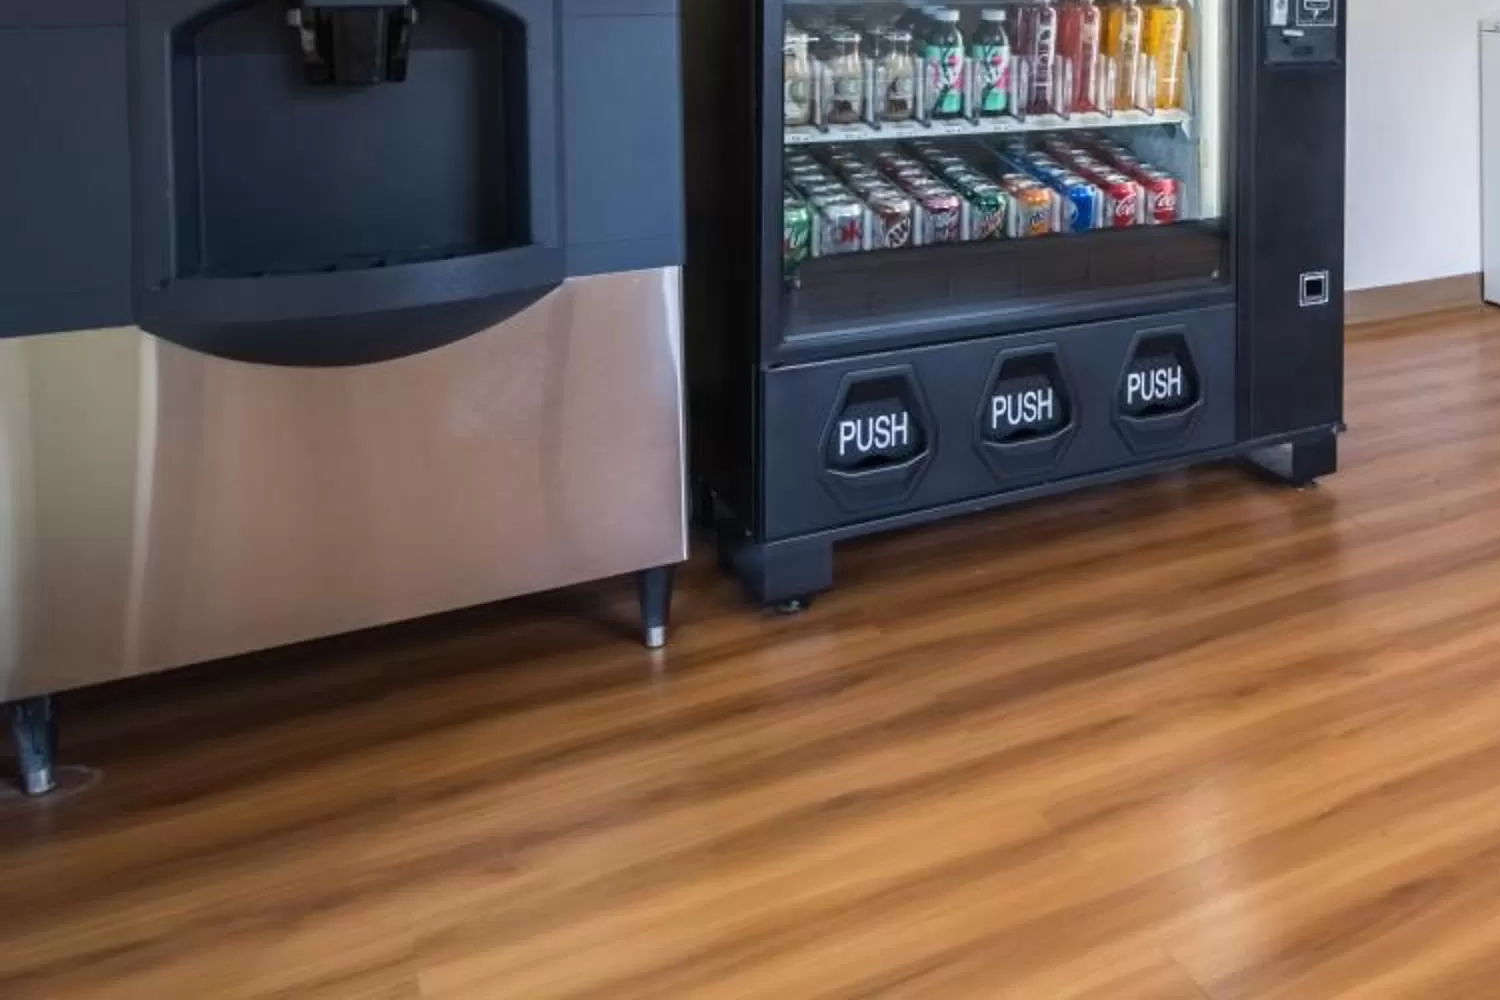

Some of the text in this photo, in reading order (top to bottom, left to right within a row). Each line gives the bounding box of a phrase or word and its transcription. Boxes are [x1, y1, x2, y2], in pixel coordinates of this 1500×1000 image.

[1127, 365, 1182, 404] PUSH
[992, 387, 1054, 430] PUSH
[839, 411, 909, 456] PUSH
